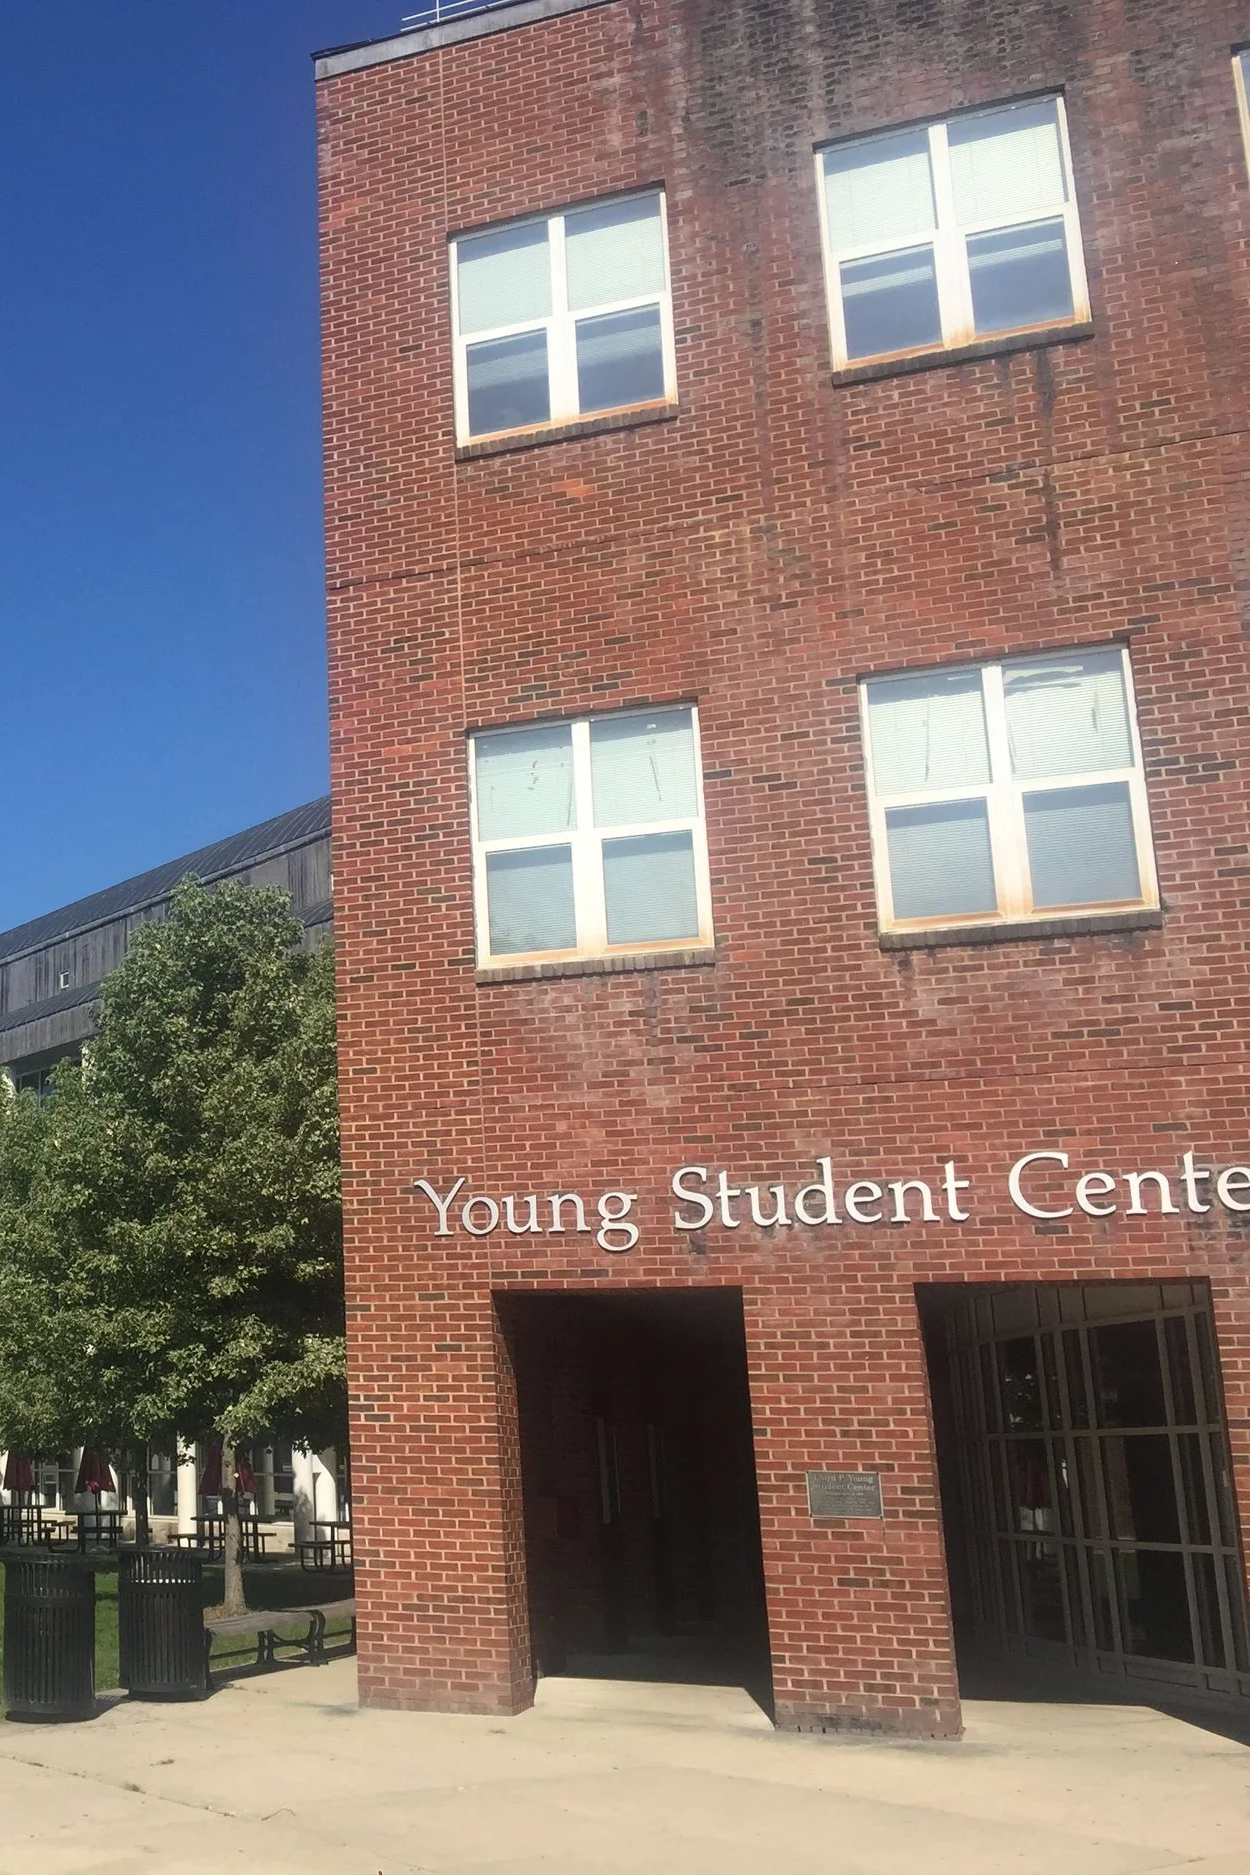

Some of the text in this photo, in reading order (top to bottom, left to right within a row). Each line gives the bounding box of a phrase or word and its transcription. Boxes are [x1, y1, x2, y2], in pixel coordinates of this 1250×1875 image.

[413, 1177, 640, 1252] Young
[671, 1156, 971, 1230] Student
[847, 1474, 874, 1484] Young
[813, 1482, 877, 1492] Student Center
